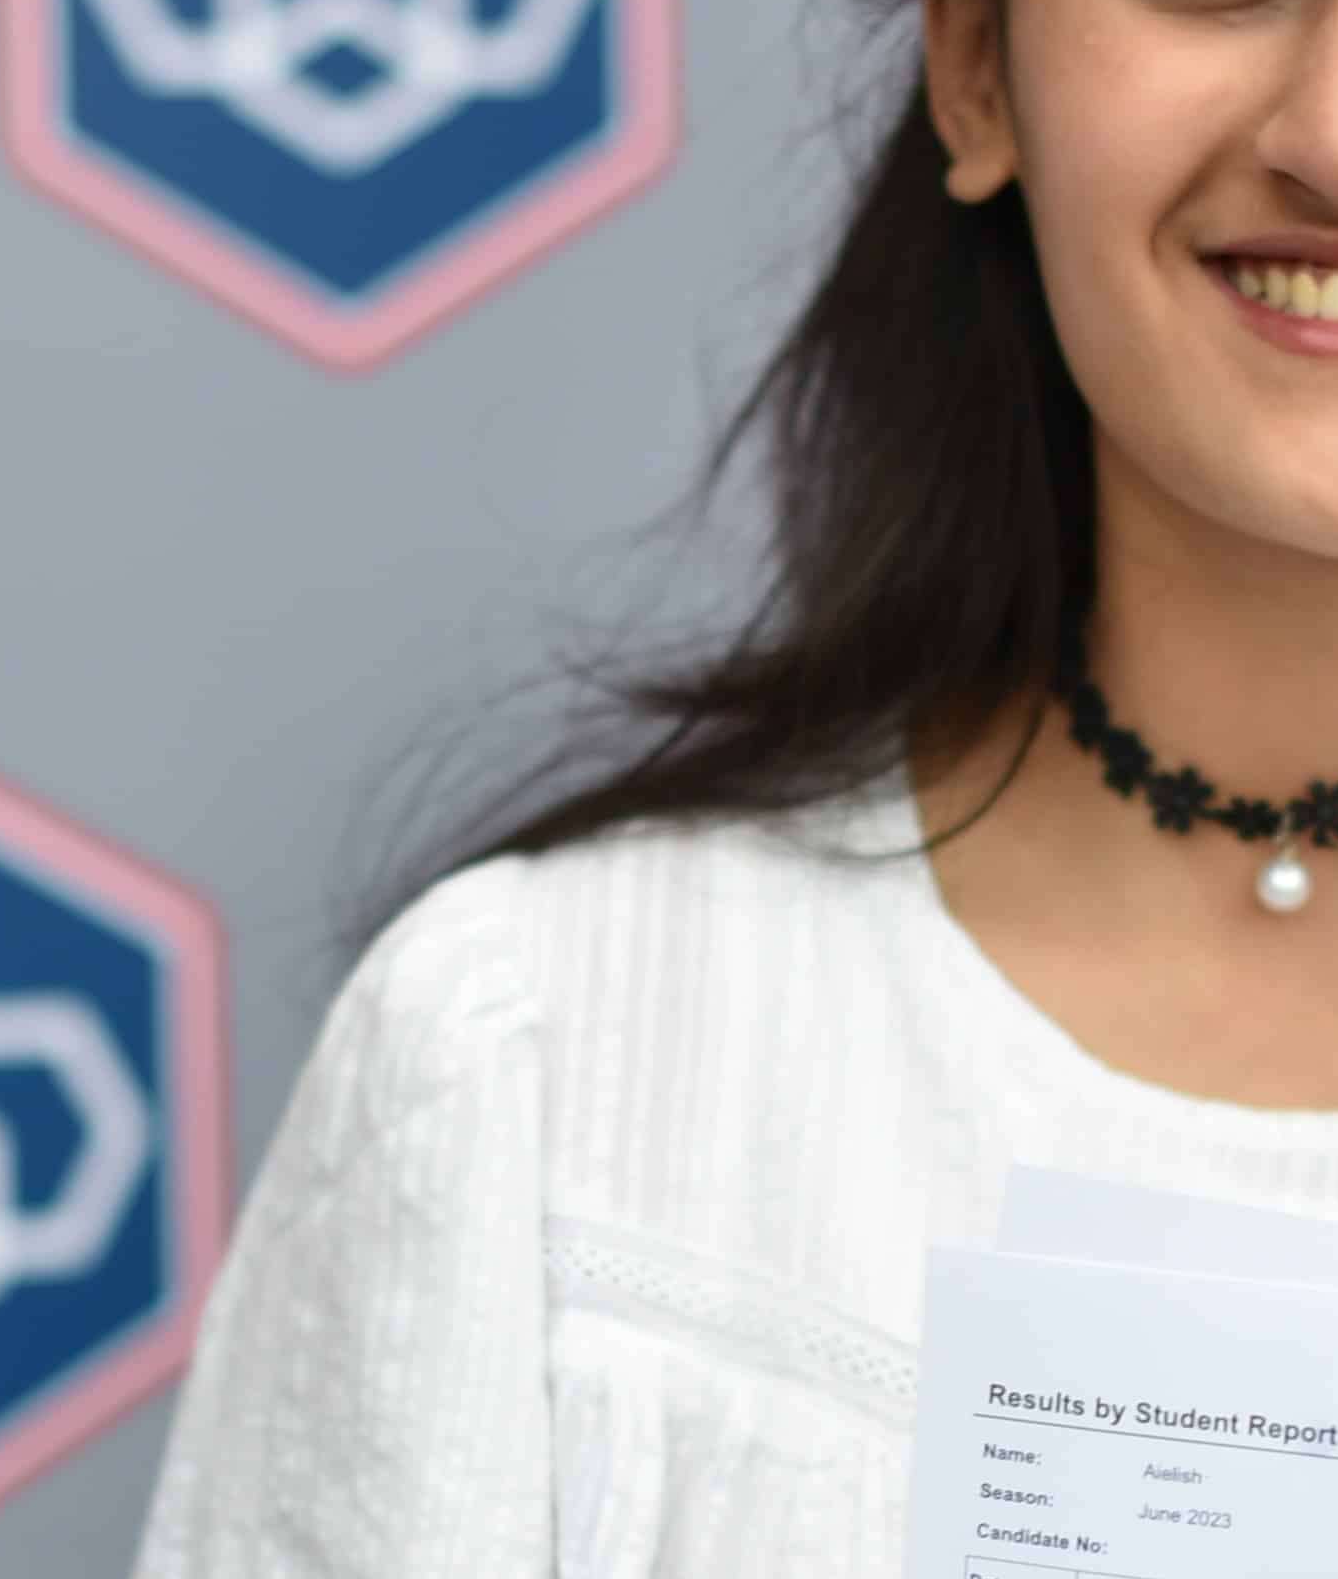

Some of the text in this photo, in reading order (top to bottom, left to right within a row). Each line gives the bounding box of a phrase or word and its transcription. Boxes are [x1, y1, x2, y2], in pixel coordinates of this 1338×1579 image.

[988, 1383, 1086, 1417] Results
[1094, 1397, 1126, 1426] by
[1135, 1401, 1240, 1436] Student
[982, 1443, 1043, 1466] Name:
[979, 1483, 1233, 1530] Season: June 2023
[975, 1522, 1109, 1555] Candidate No:
